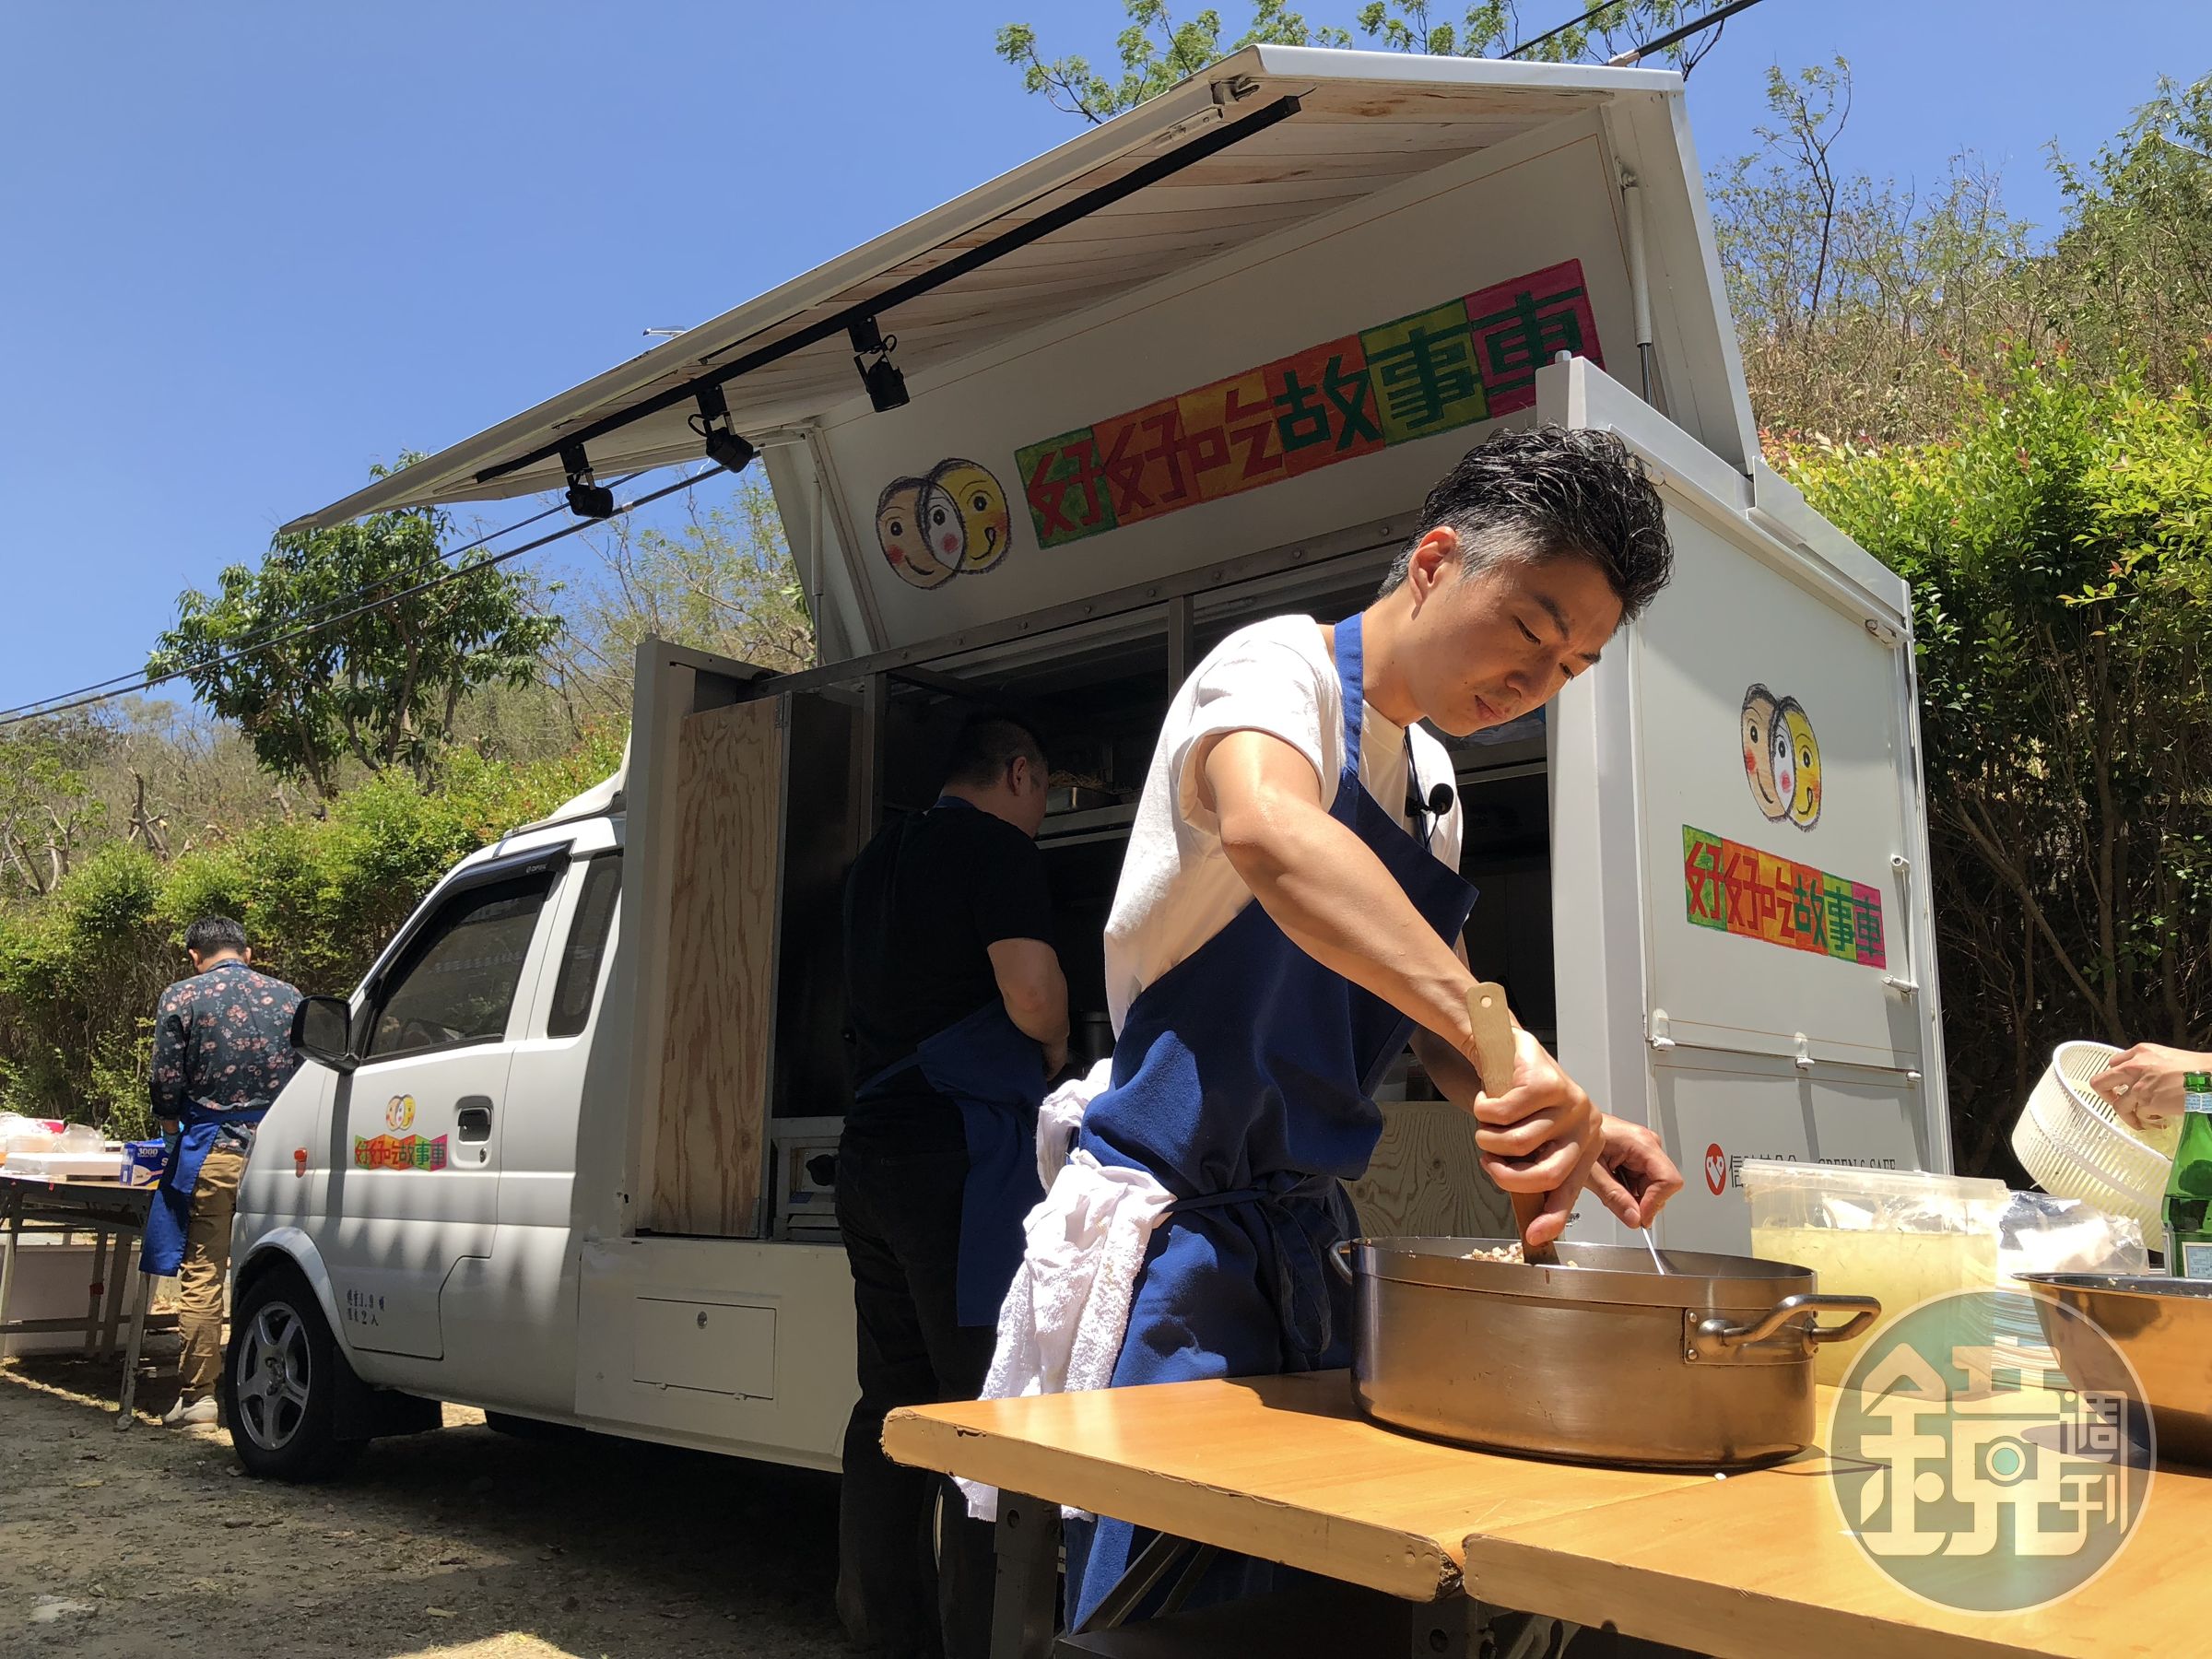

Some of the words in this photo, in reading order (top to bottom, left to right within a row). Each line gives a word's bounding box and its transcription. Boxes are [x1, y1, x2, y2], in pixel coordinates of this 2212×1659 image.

[1025, 286, 1602, 539] 好好吃故事車
[1684, 841, 1884, 958] 好好吃故事車
[355, 1140, 445, 1166] 好好吃故事車
